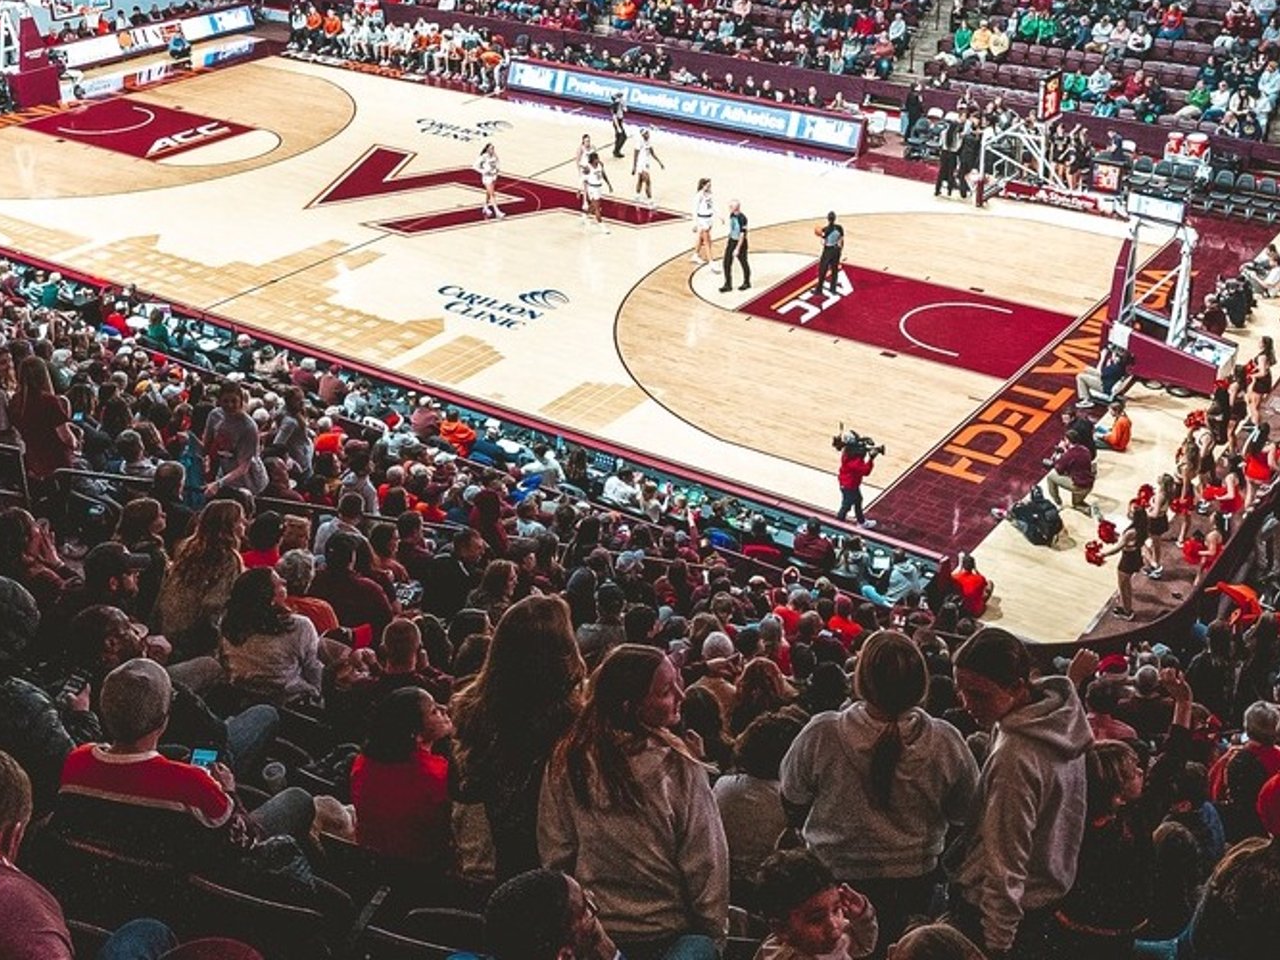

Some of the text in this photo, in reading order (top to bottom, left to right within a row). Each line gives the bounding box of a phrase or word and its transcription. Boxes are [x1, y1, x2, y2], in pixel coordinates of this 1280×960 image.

[630, 86, 680, 110] Dentist
[681, 99, 697, 114] of
[699, 101, 721, 118] VT
[721, 103, 786, 130] Athletics
[145, 122, 231, 158] ACC
[438, 285, 544, 320] CARILION
[444, 301, 527, 330] CLINIC
[925, 385, 1076, 484] TECH
